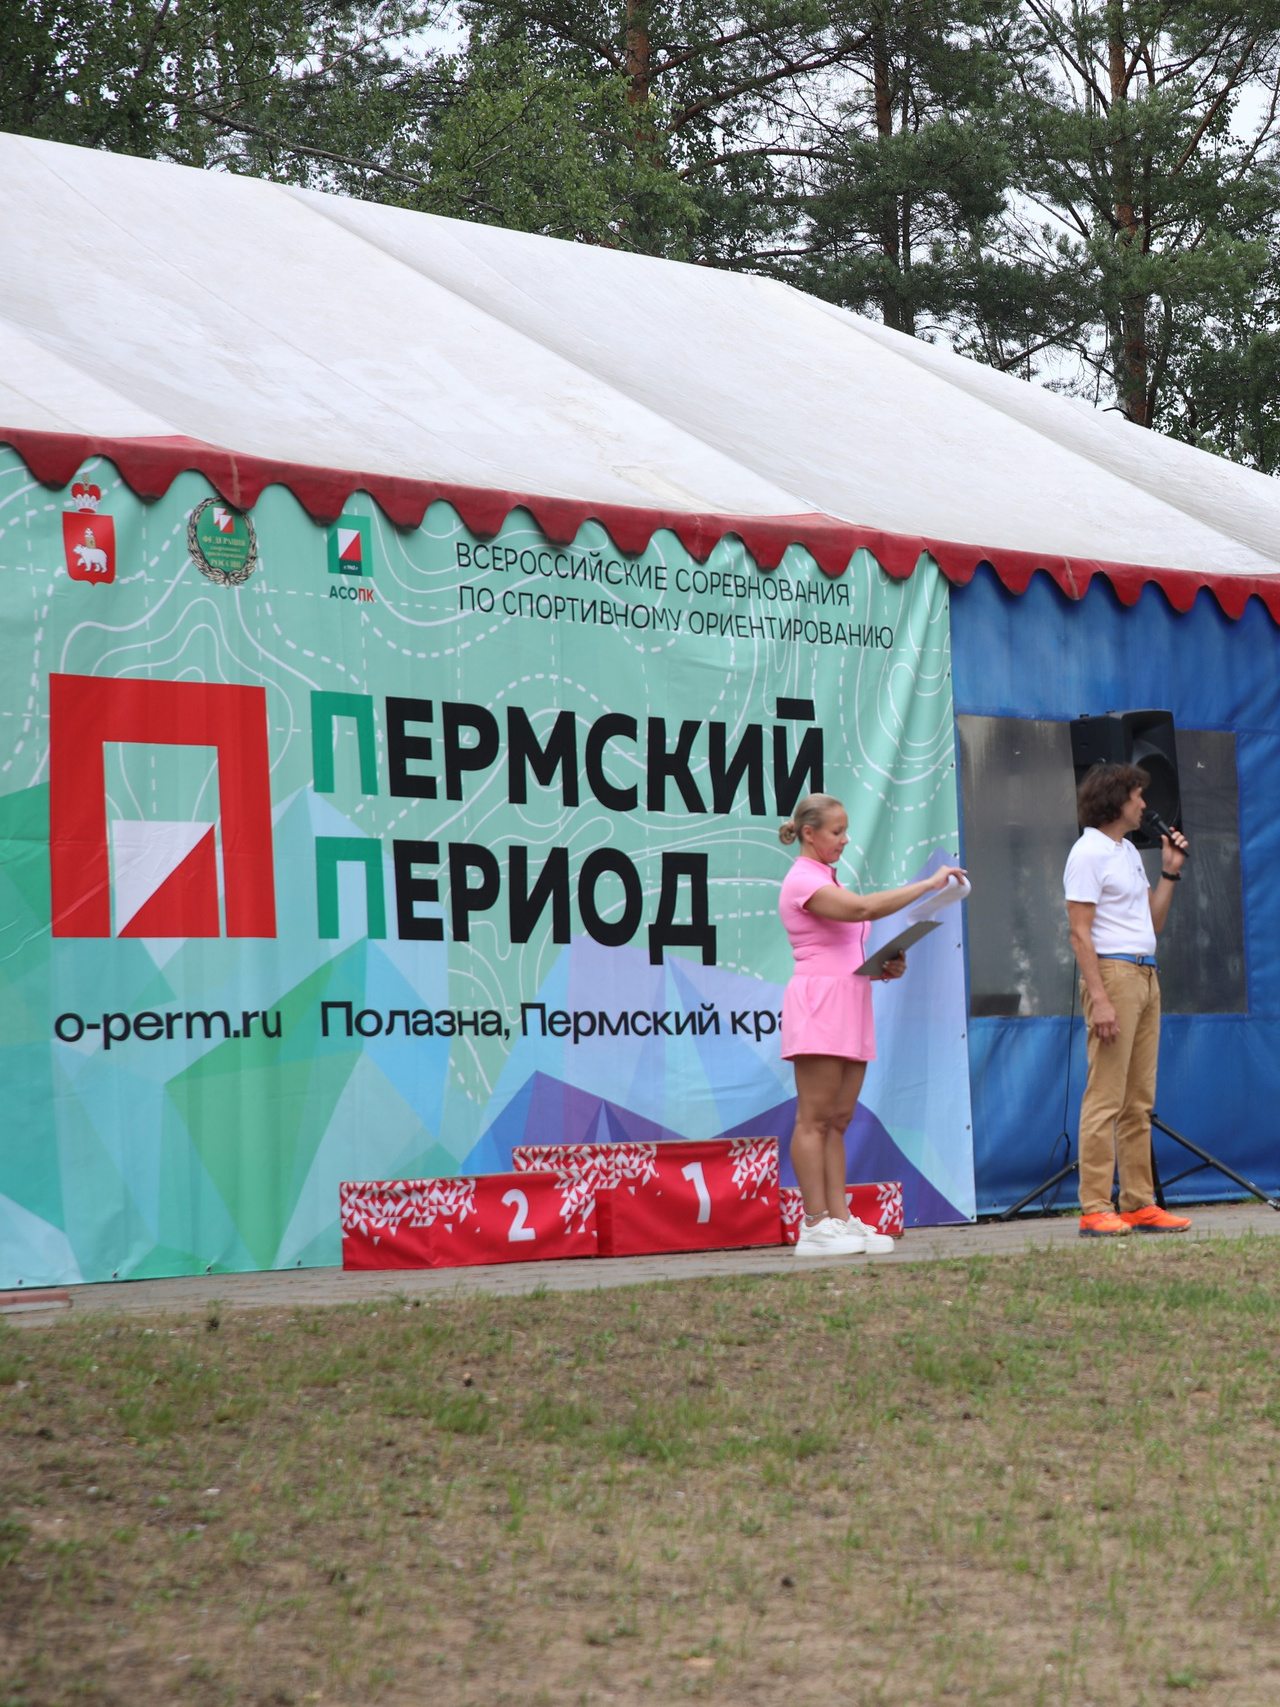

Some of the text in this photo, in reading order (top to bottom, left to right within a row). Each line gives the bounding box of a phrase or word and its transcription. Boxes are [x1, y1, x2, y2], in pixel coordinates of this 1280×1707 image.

[329, 585, 375, 603] АСОПК
[456, 542, 850, 607] ВСЕРОССИЙСКИЕ СОРЕВНОВАНИЯ
[459, 586, 894, 650] ПО СПОРТИВНОМУ ОРИЕНТИРОВАНИЮ
[310, 690, 825, 817] ПЕРМСКИЙ
[315, 836, 717, 966] ПЕРИОД
[54, 1010, 282, 1051] o-perm.ru
[320, 1001, 783, 1045] Полазна, Пермский кр
[501, 1188, 536, 1243] 2
[681, 1161, 711, 1224] 1
